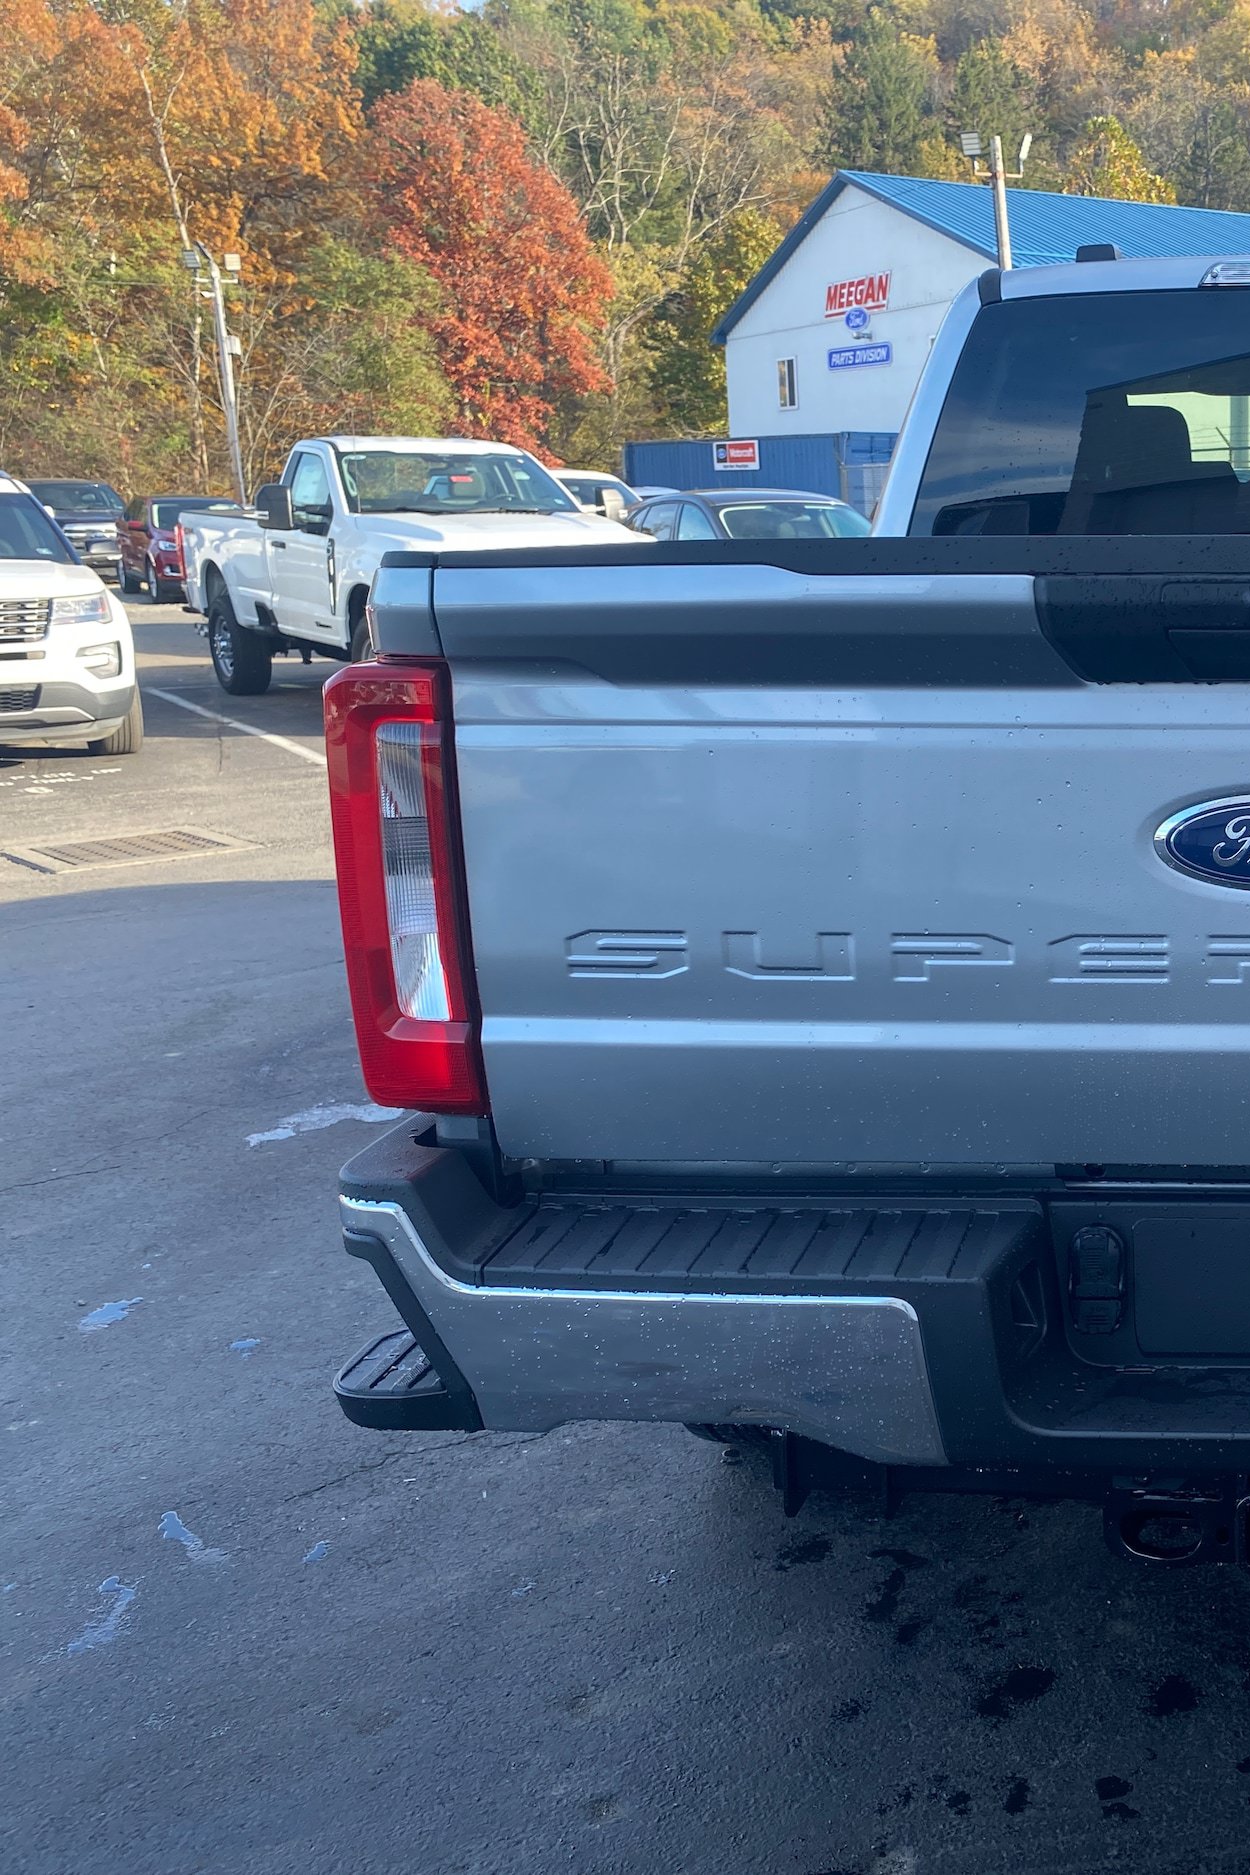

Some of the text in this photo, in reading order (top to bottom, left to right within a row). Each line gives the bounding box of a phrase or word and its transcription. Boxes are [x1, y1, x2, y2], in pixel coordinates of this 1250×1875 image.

[826, 274, 888, 311] MEEGAN
[831, 346, 888, 367] PARTS DIVISION
